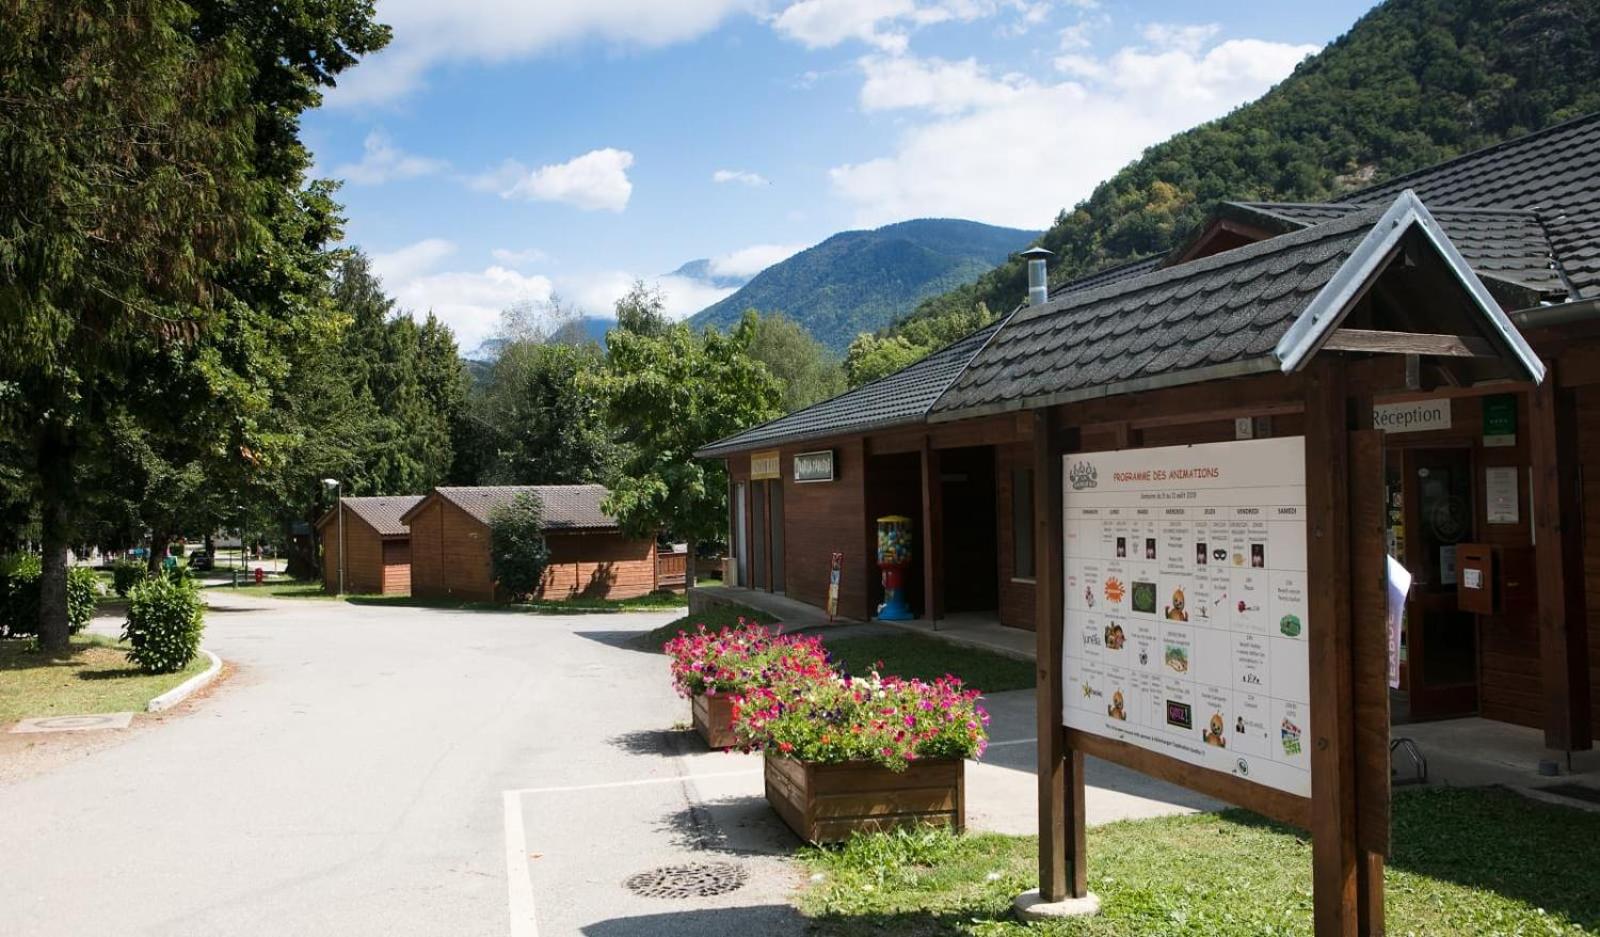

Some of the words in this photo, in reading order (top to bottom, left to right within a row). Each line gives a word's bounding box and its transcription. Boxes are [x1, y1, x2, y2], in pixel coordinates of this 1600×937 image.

[1373, 406, 1441, 428] Réception
[1112, 471, 1151, 482] PROGRAMME
[1152, 469, 1167, 480] DES
[1168, 467, 1219, 479] ANIMATIONS
